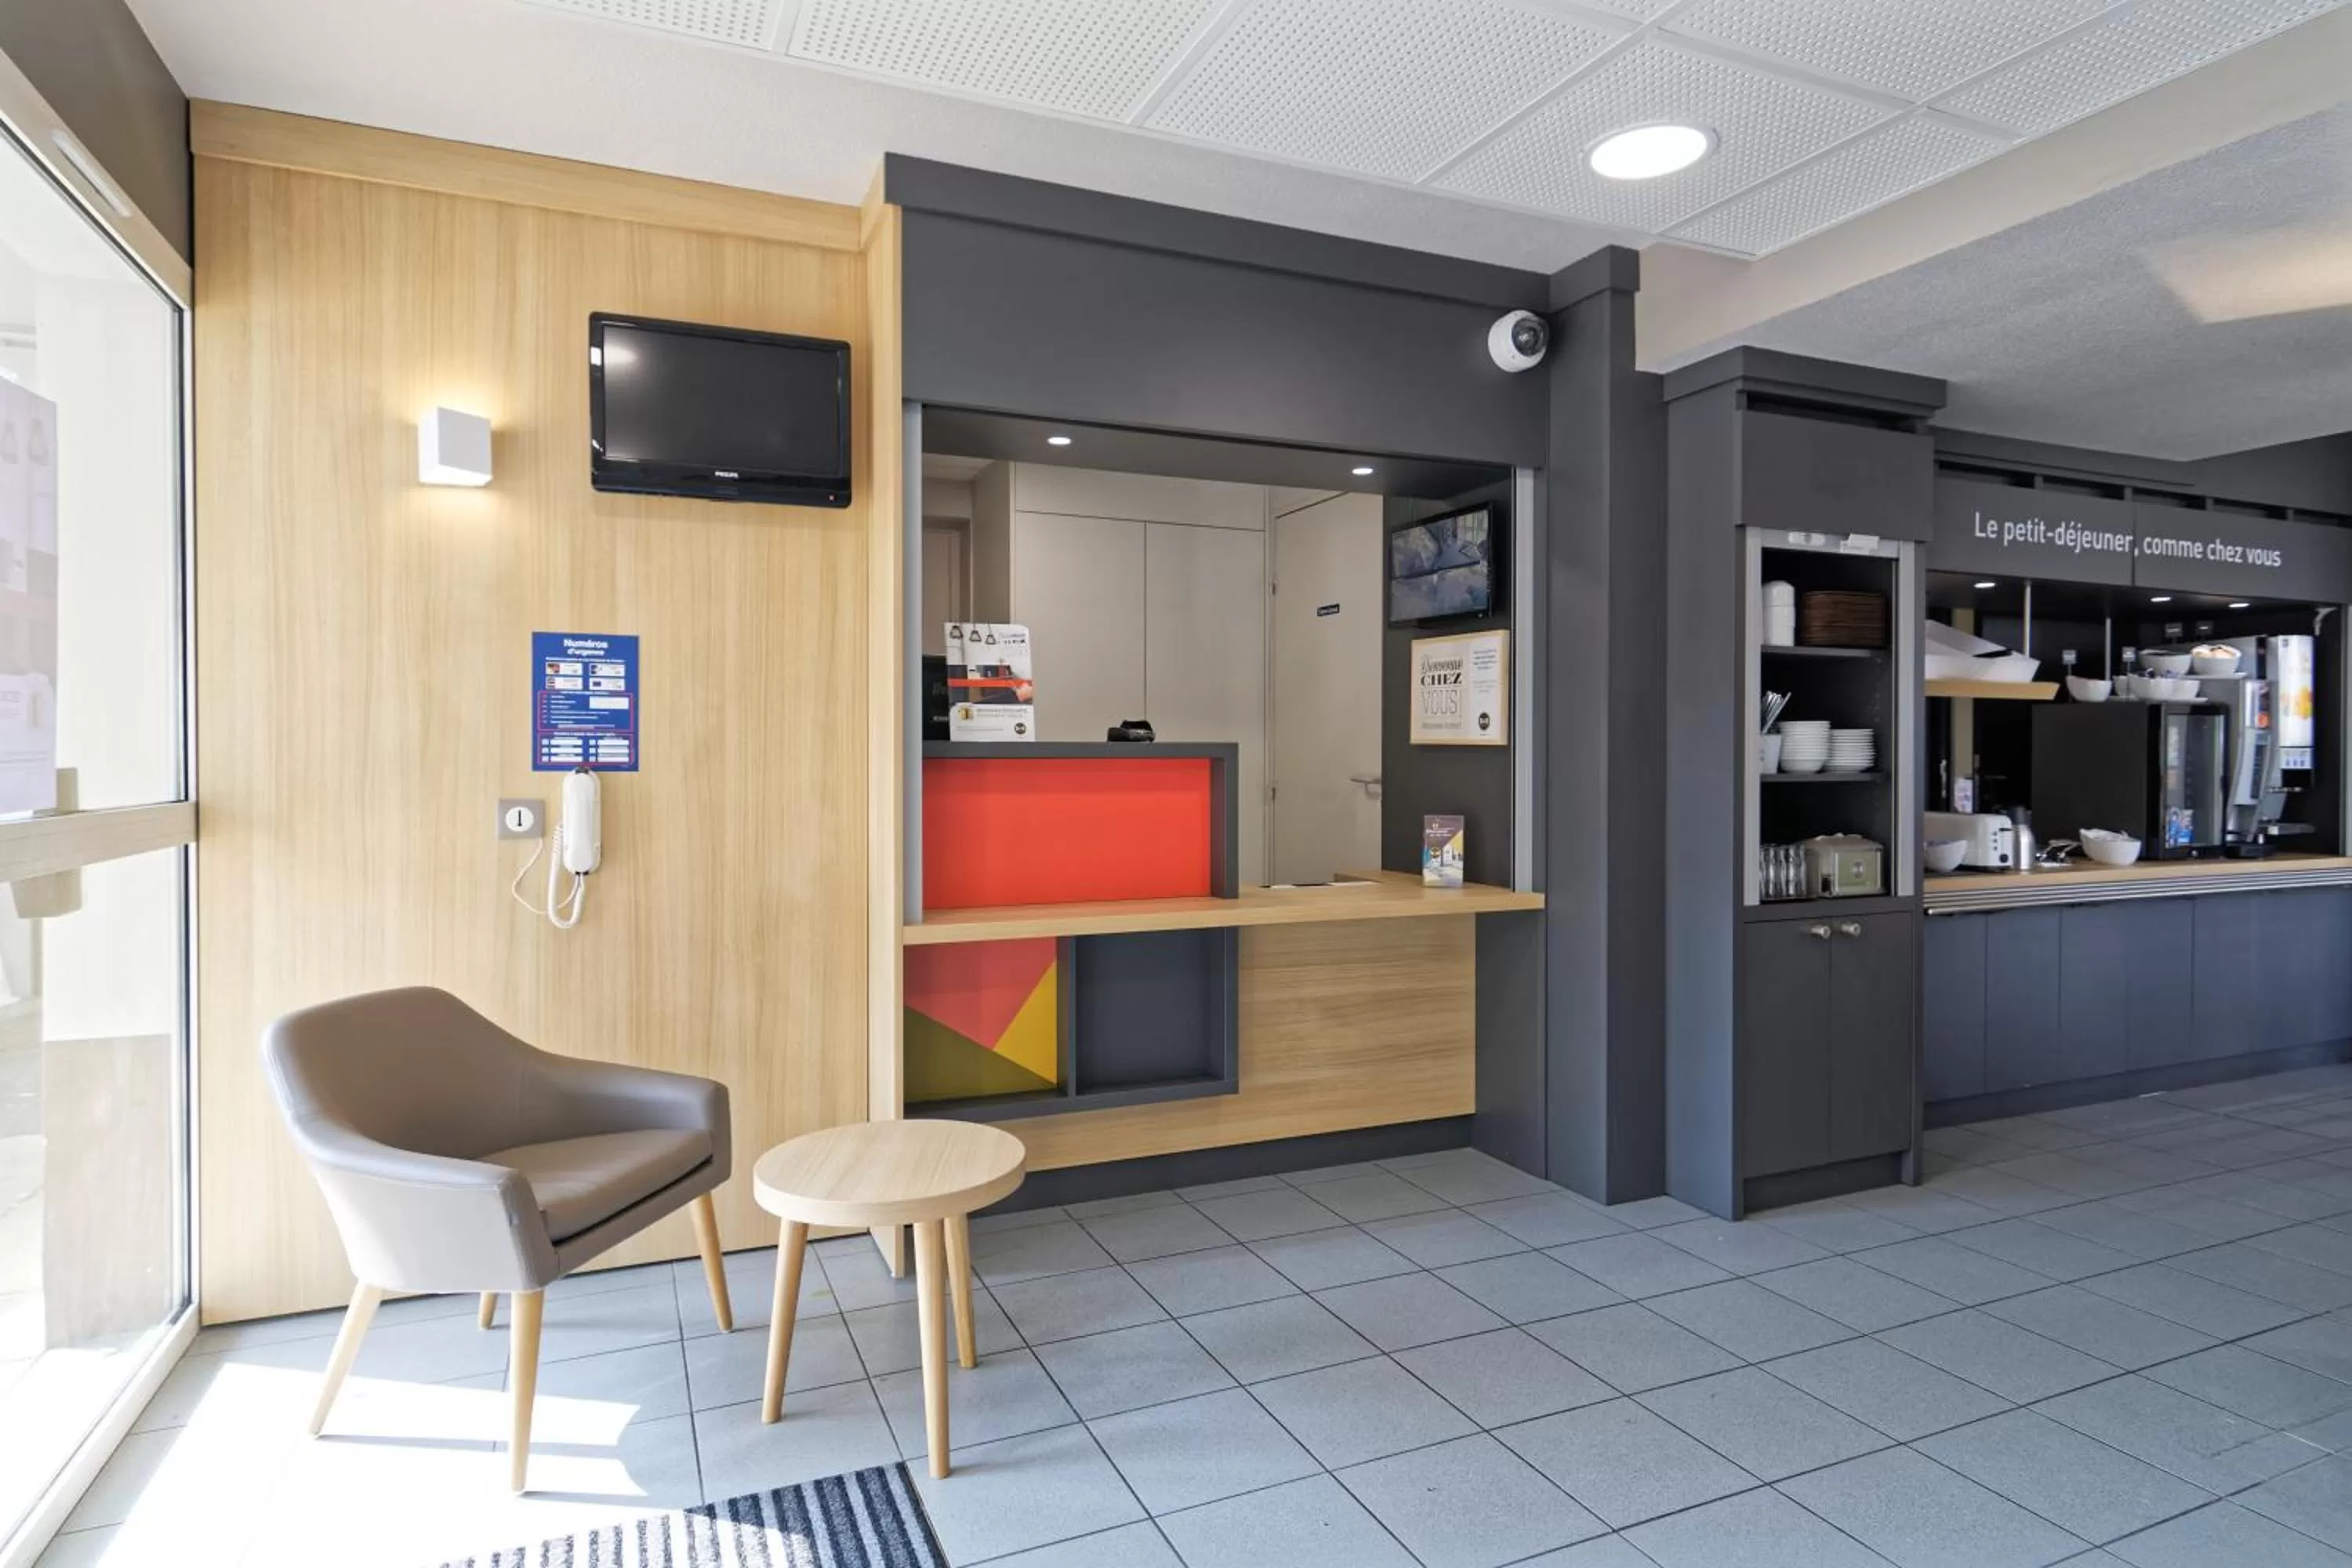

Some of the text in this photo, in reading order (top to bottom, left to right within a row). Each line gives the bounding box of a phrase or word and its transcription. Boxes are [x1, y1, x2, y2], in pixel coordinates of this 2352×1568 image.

[1975, 511, 2282, 568] Le petit-déjeuner, comme chez vous
[1421, 672, 1462, 687] CHEZ
